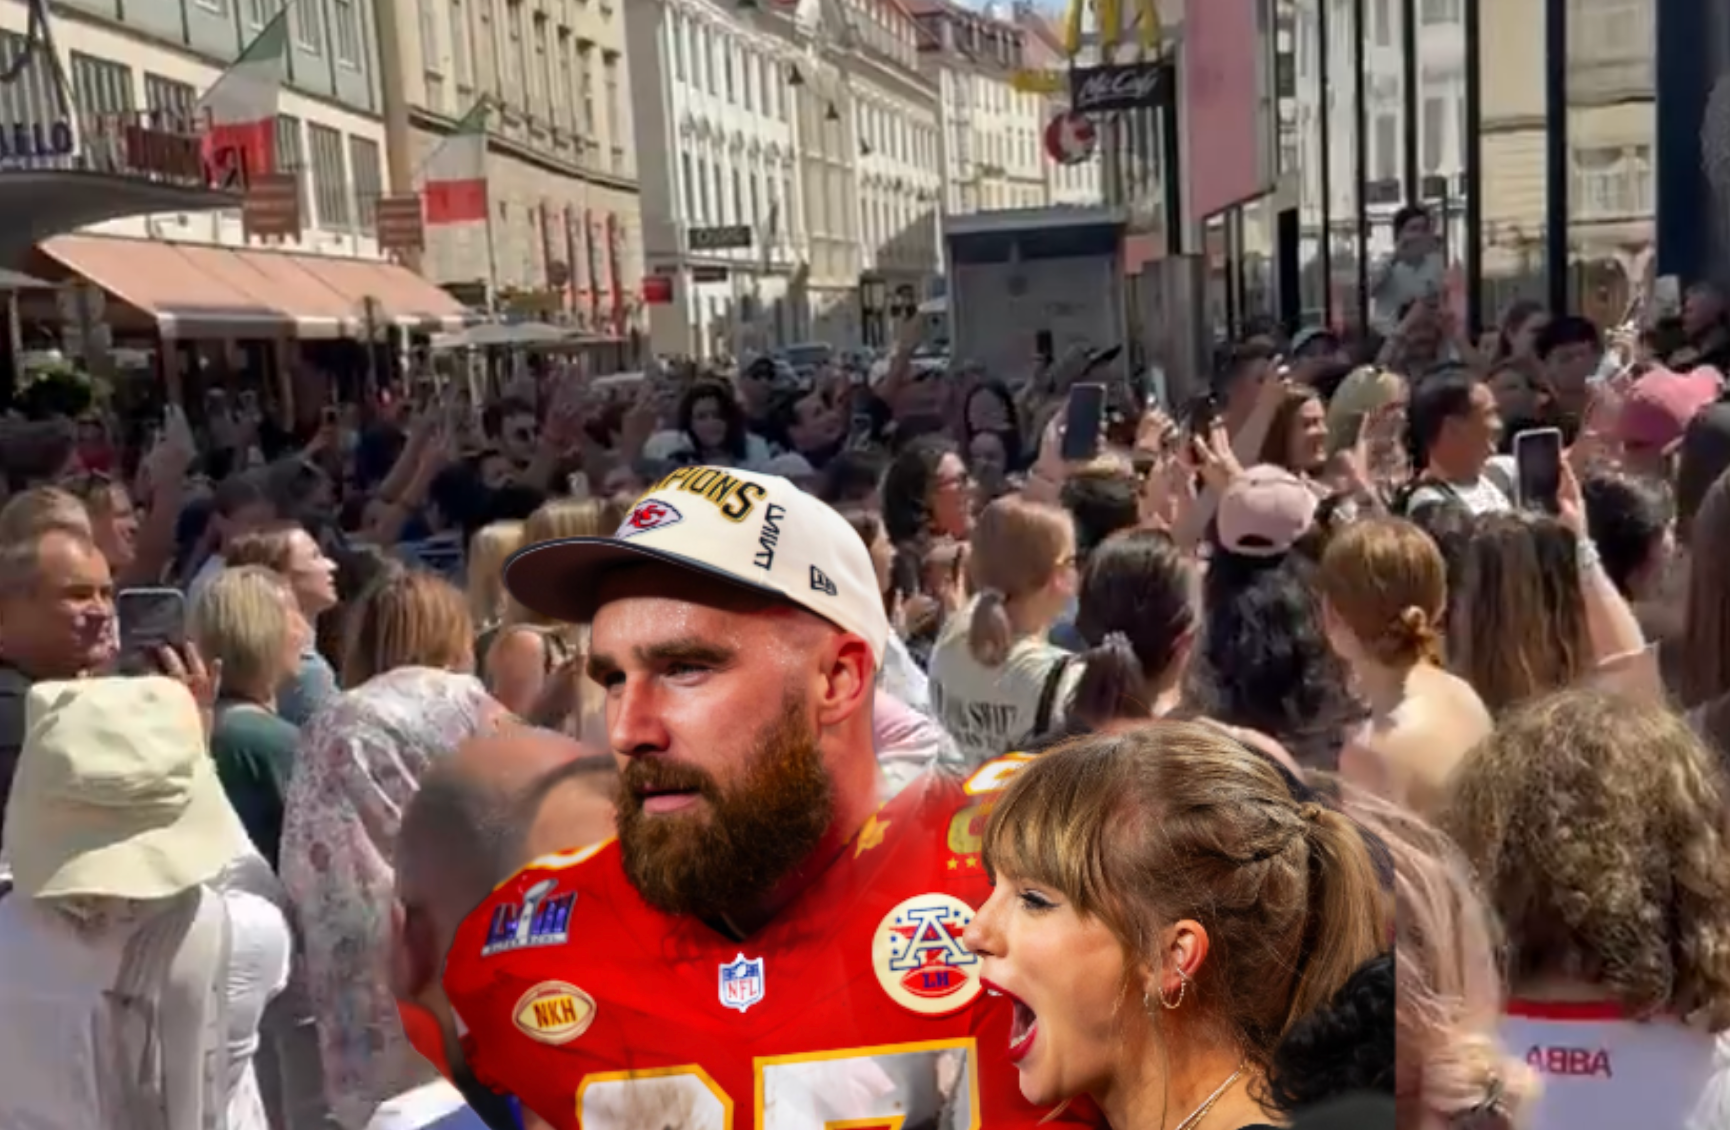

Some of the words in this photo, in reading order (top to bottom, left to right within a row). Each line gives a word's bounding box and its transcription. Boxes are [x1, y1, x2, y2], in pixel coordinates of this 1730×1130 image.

[728, 978, 757, 1000] NFL
[533, 996, 577, 1029] NKH
[1526, 1046, 1612, 1079] ABBA
